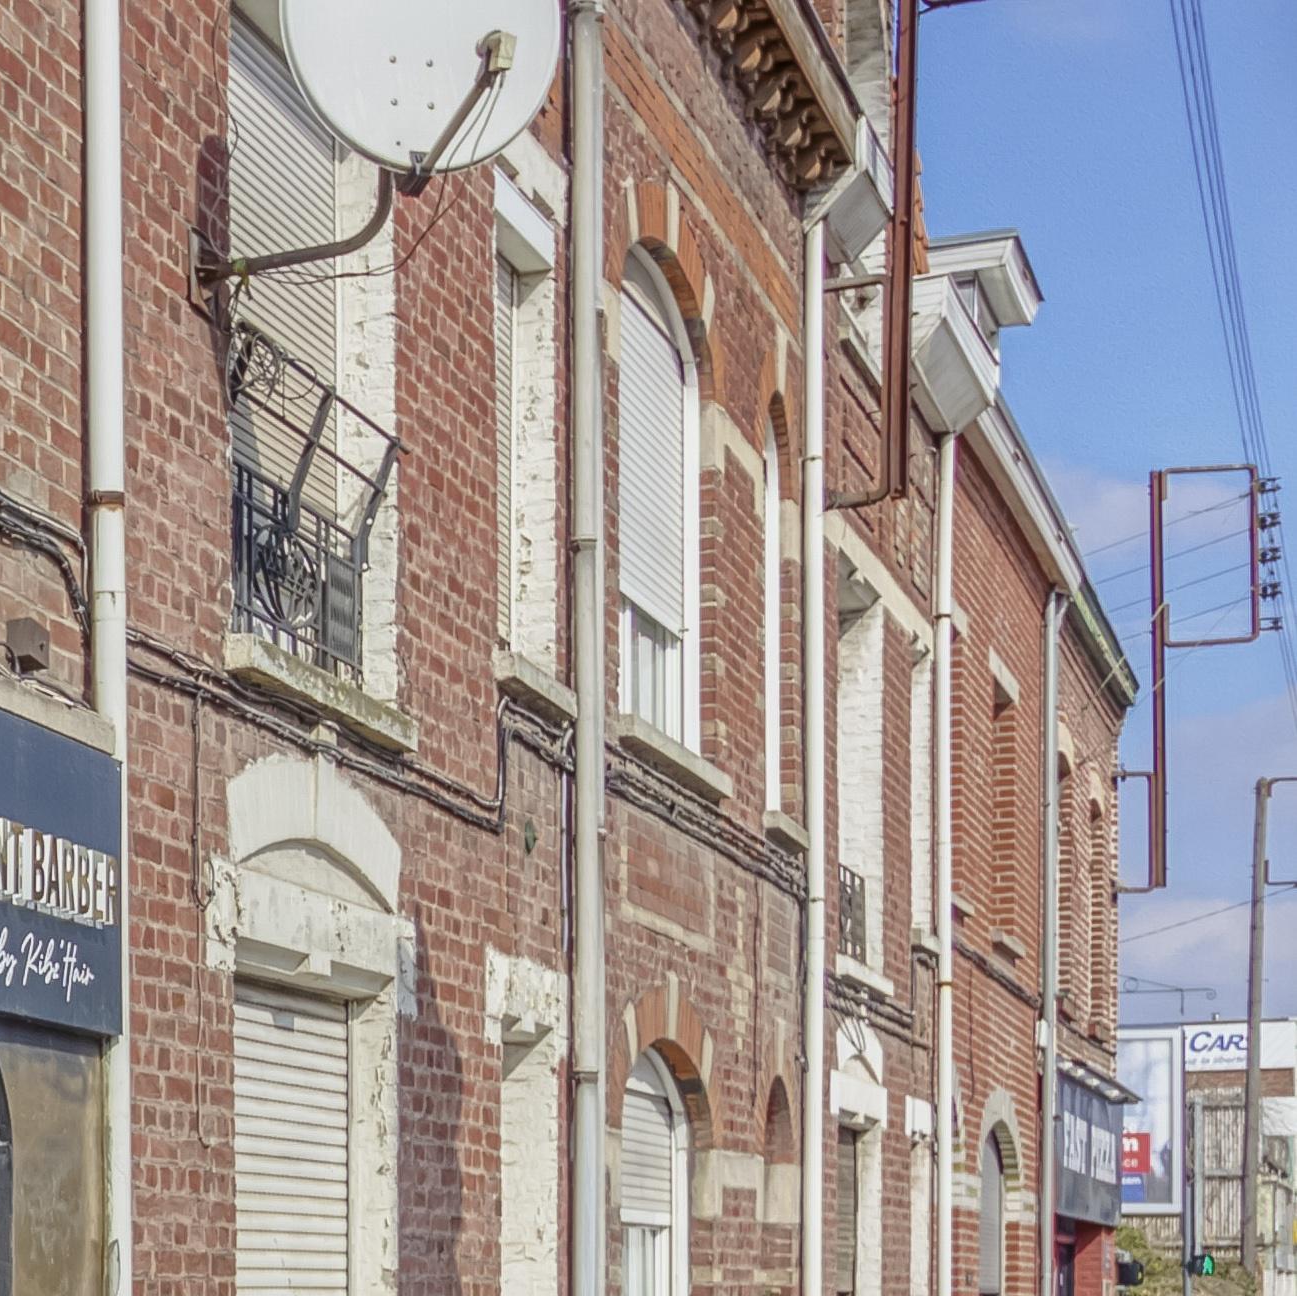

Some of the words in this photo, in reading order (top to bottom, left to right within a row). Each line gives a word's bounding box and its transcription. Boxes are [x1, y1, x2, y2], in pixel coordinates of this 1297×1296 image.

[21, 826, 116, 926] BARBER
[1189, 1031, 1247, 1053] CAR
[1064, 1110, 1088, 1175] FAST
